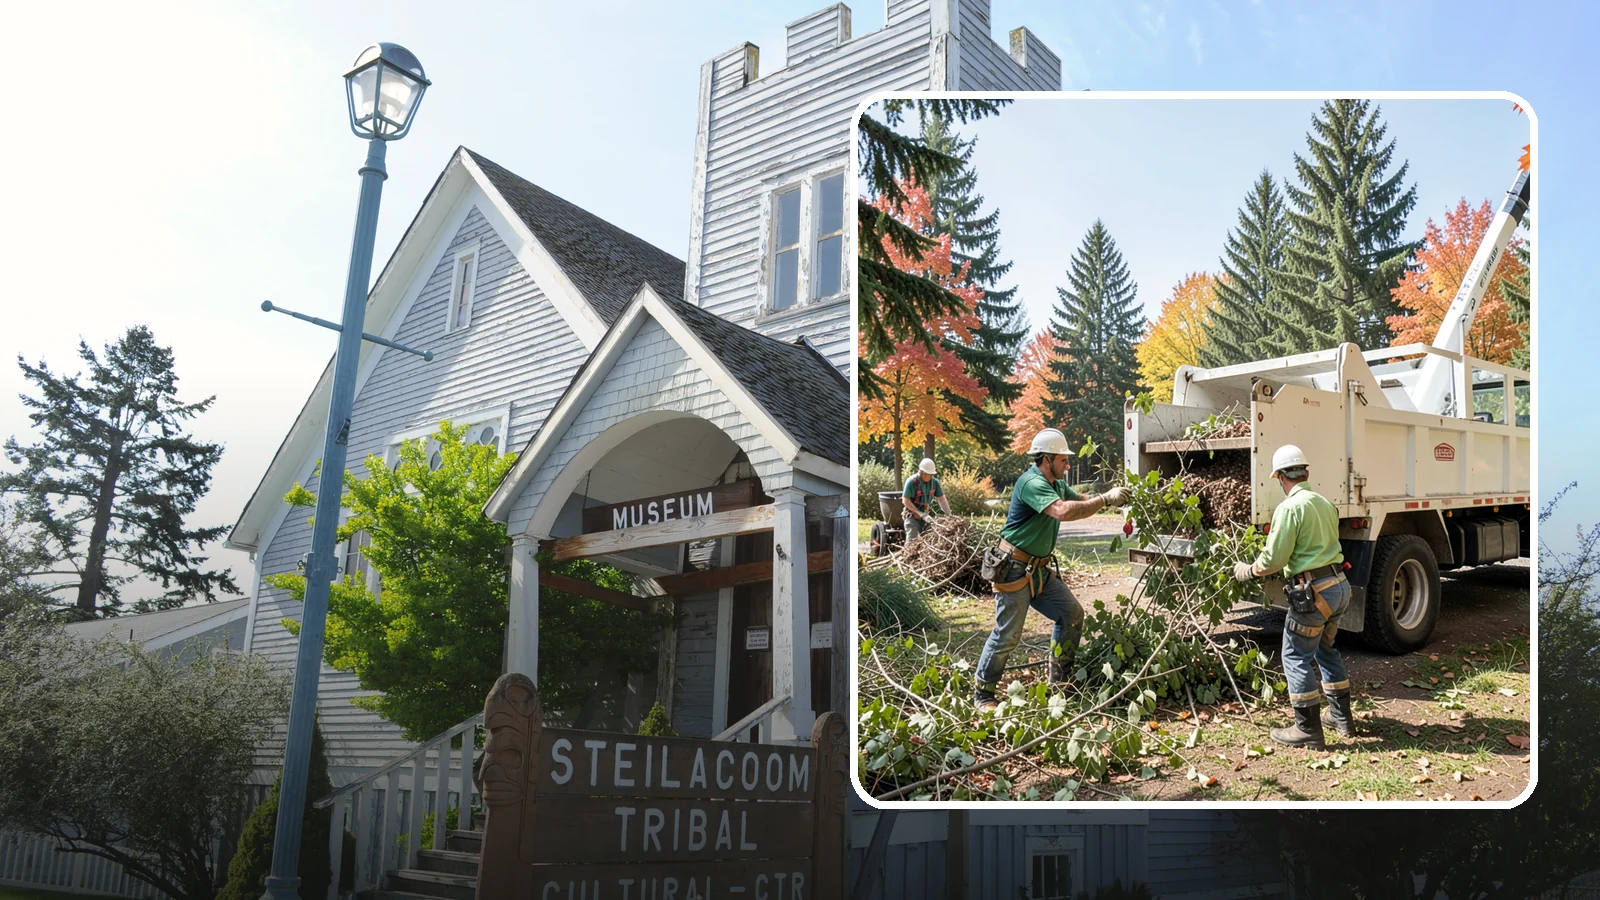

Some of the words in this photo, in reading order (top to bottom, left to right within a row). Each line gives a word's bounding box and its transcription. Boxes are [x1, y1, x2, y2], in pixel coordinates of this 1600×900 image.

[613, 491, 714, 531] MUSEUM
[550, 738, 809, 792] STEILACOOM
[614, 806, 758, 852] TRIBAL
